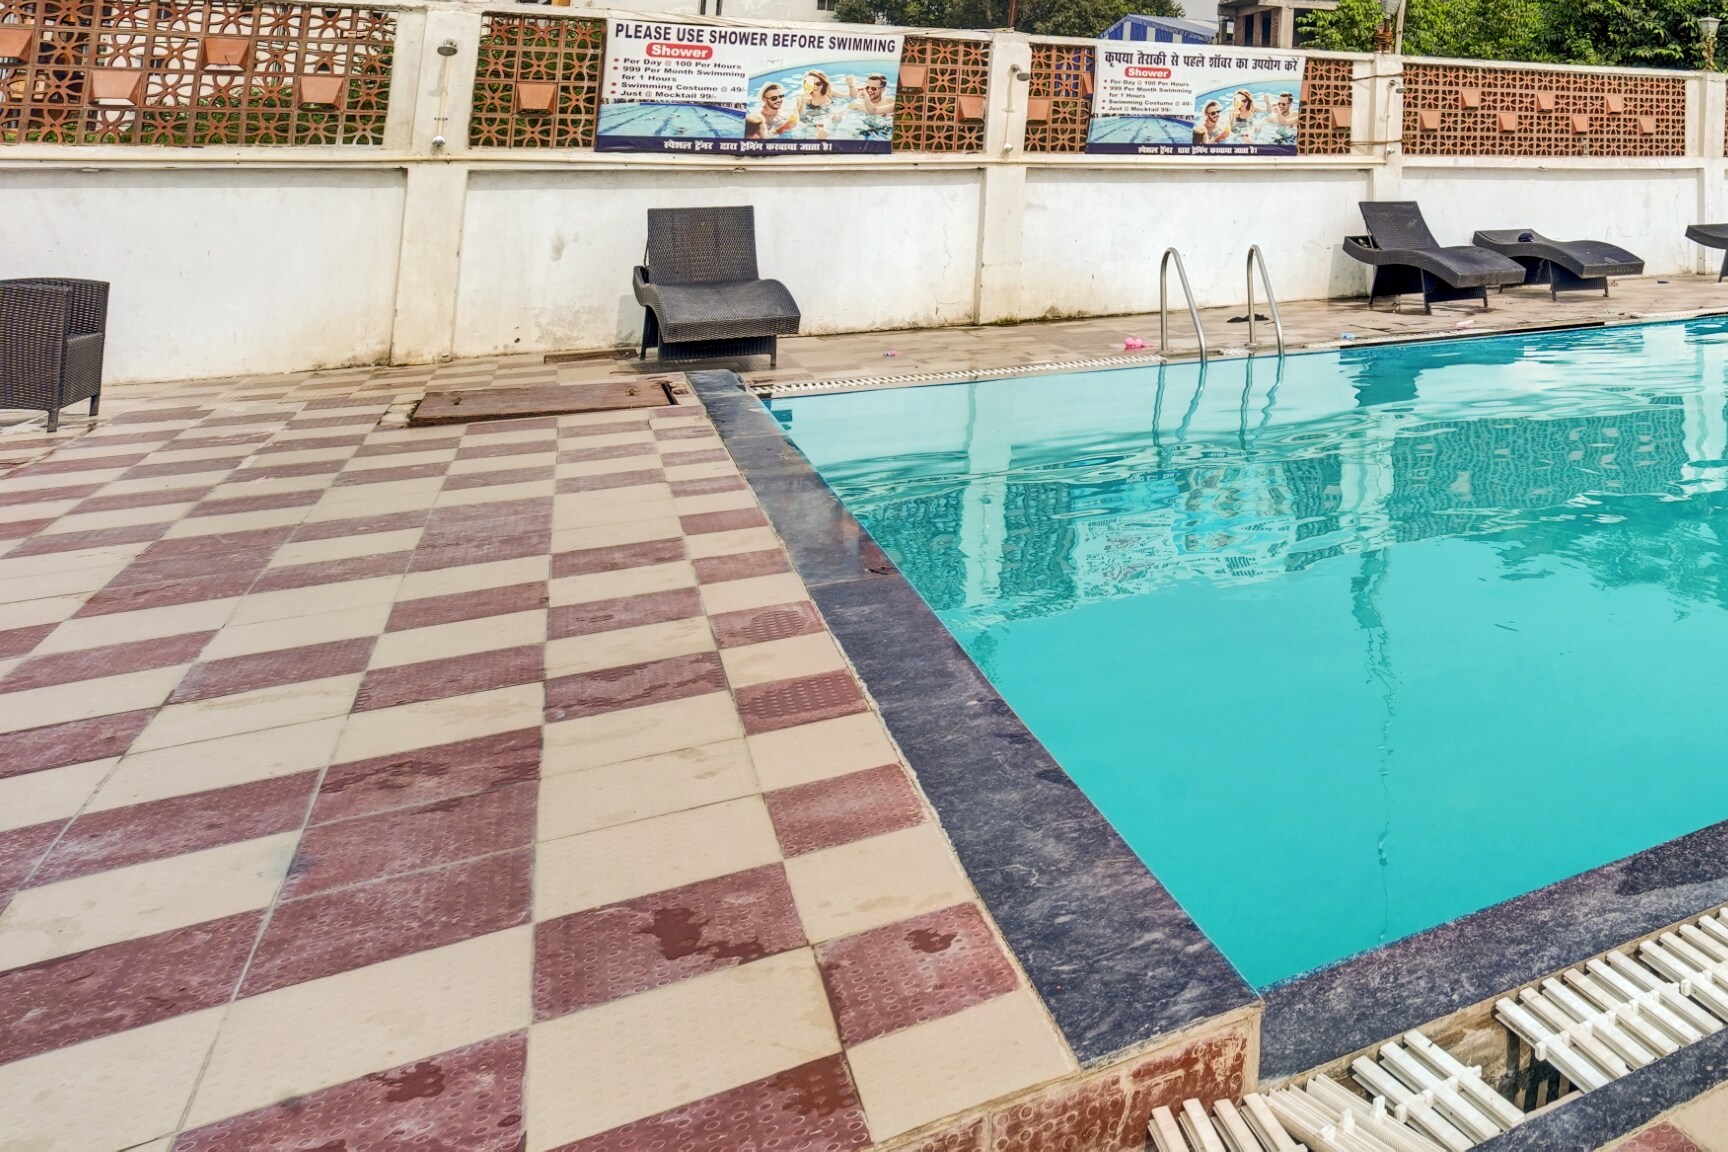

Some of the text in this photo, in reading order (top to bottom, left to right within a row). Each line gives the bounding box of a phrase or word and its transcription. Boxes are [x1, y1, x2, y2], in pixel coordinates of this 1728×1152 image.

[615, 23, 896, 53] PLEASE USE SHOWER BEFORE SWIMMING
[651, 44, 708, 58] Shower
[1105, 49, 1300, 71] कृपया तैराकी से पहले शॉवर का उपयोग करें
[697, 69, 746, 78] Swimming
[1128, 68, 1168, 78] Shower
[621, 82, 673, 91] Swimming
[676, 84, 718, 92] Costume
